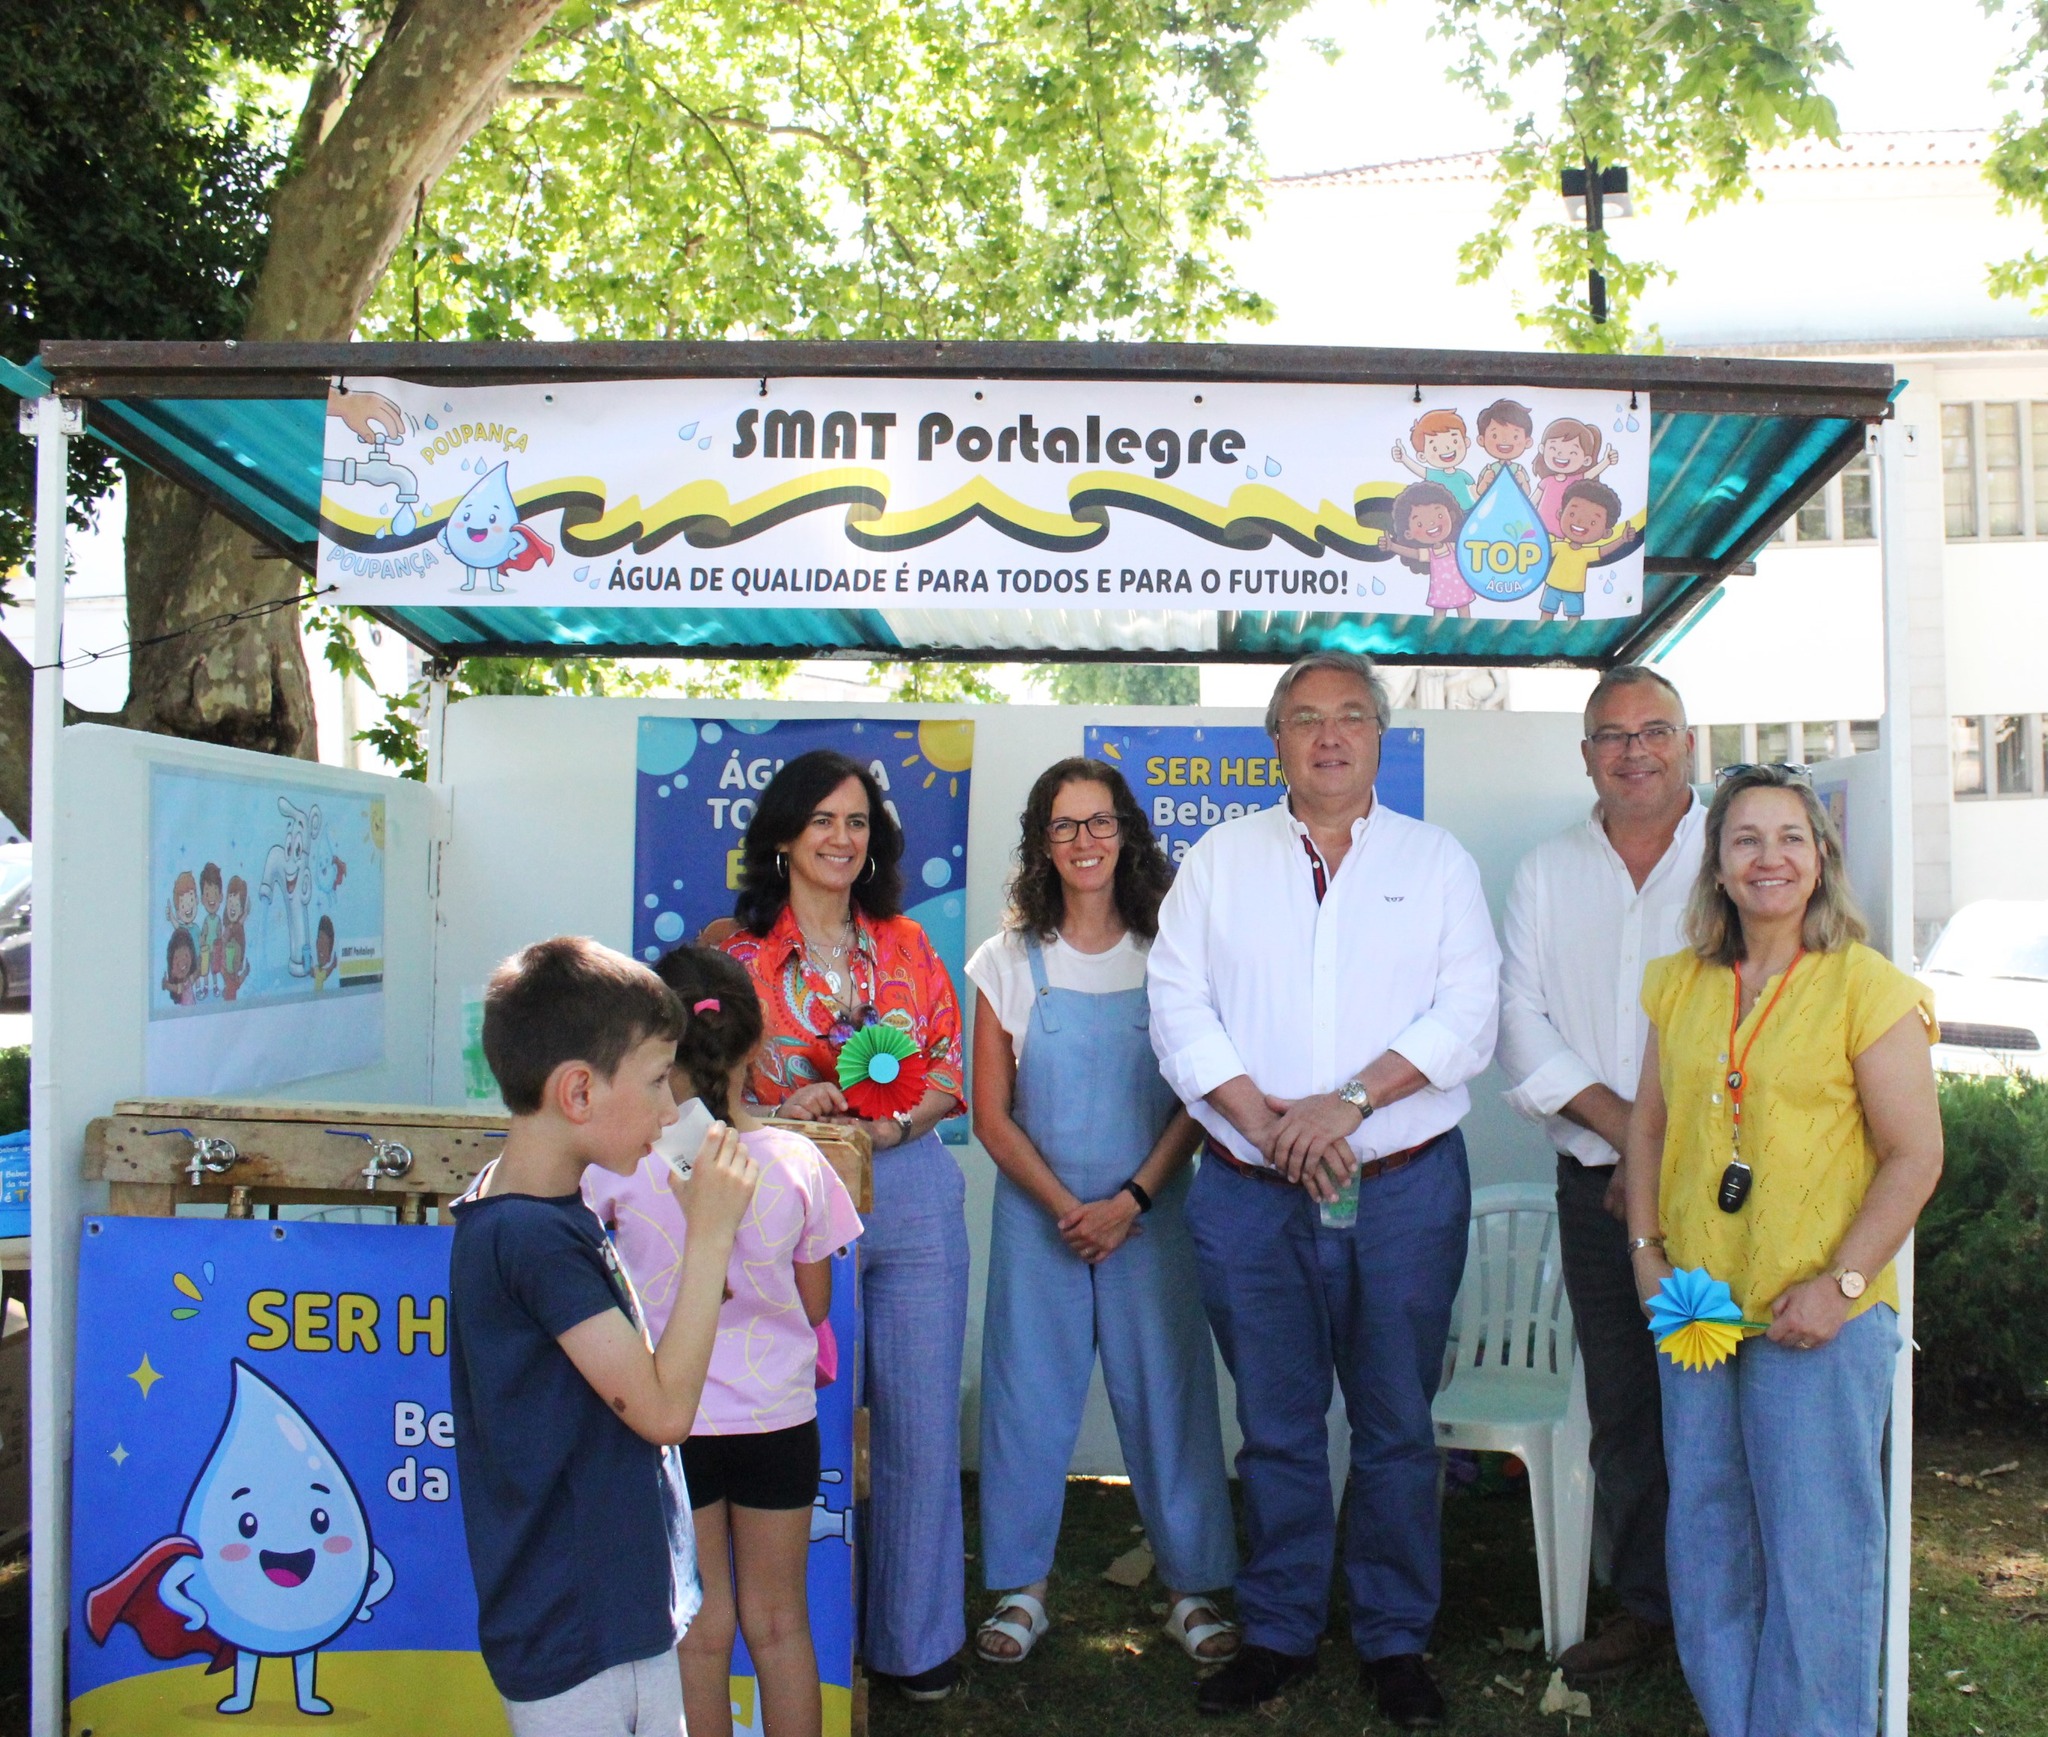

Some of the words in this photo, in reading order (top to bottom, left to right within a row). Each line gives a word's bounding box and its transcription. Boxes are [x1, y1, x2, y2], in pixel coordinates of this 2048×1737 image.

[420, 422, 529, 465] POUPANÇA
[732, 408, 897, 460] SMAT
[918, 412, 1246, 479] Portalegre
[326, 544, 440, 579] POUPANÇA
[1464, 539, 1543, 575] TOP
[608, 558, 681, 591] ÁGUA
[690, 567, 724, 592] DE
[731, 567, 887, 597] QUALIDADE
[895, 561, 910, 593] É
[917, 569, 989, 593] PARA
[997, 569, 1089, 593] TODOS
[1097, 569, 1112, 593] E
[1120, 568, 1193, 593] PARA
[1200, 568, 1221, 594] O
[1229, 569, 1348, 595] FUTURO!
[1485, 576, 1523, 593] ÁGUA
[719, 749, 784, 791] ÁG
[1146, 756, 1212, 787] SER
[246, 1288, 381, 1355] SER
[386, 1455, 450, 1502] da
